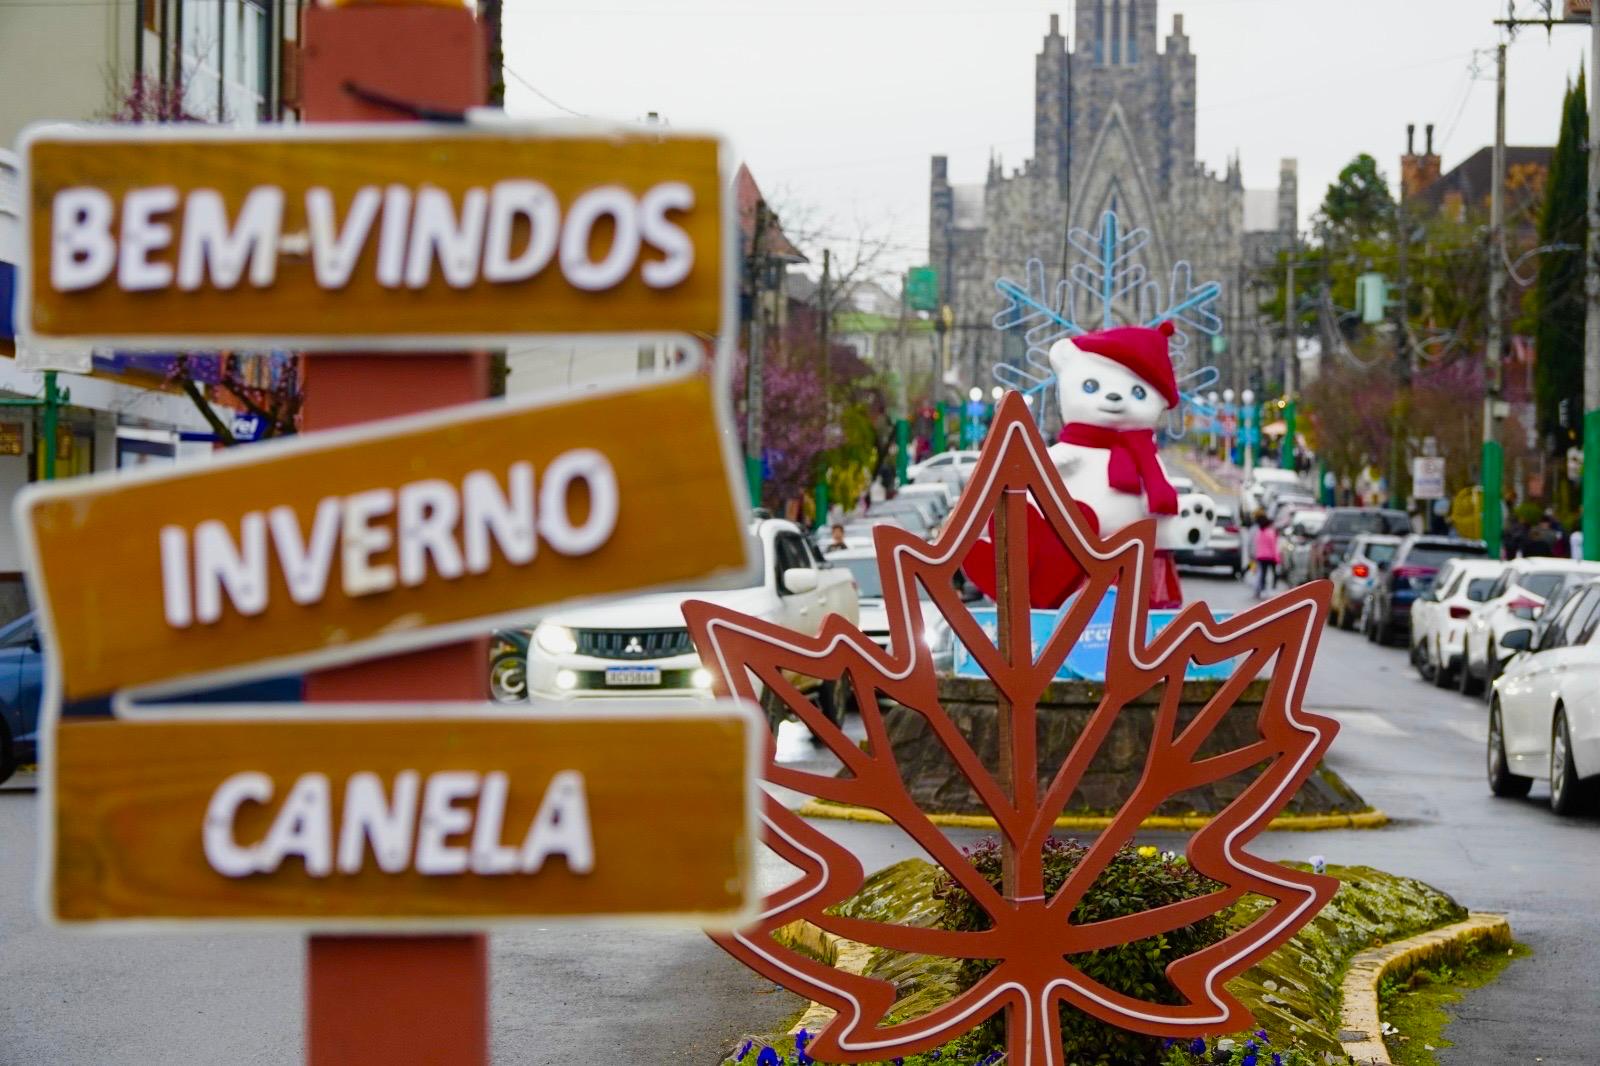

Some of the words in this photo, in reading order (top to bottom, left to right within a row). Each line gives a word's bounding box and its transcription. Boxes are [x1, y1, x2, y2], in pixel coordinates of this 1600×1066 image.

[50, 179, 695, 291] BEM-VINDOS
[161, 449, 618, 627] INVERNO
[203, 769, 593, 877] CANELA
